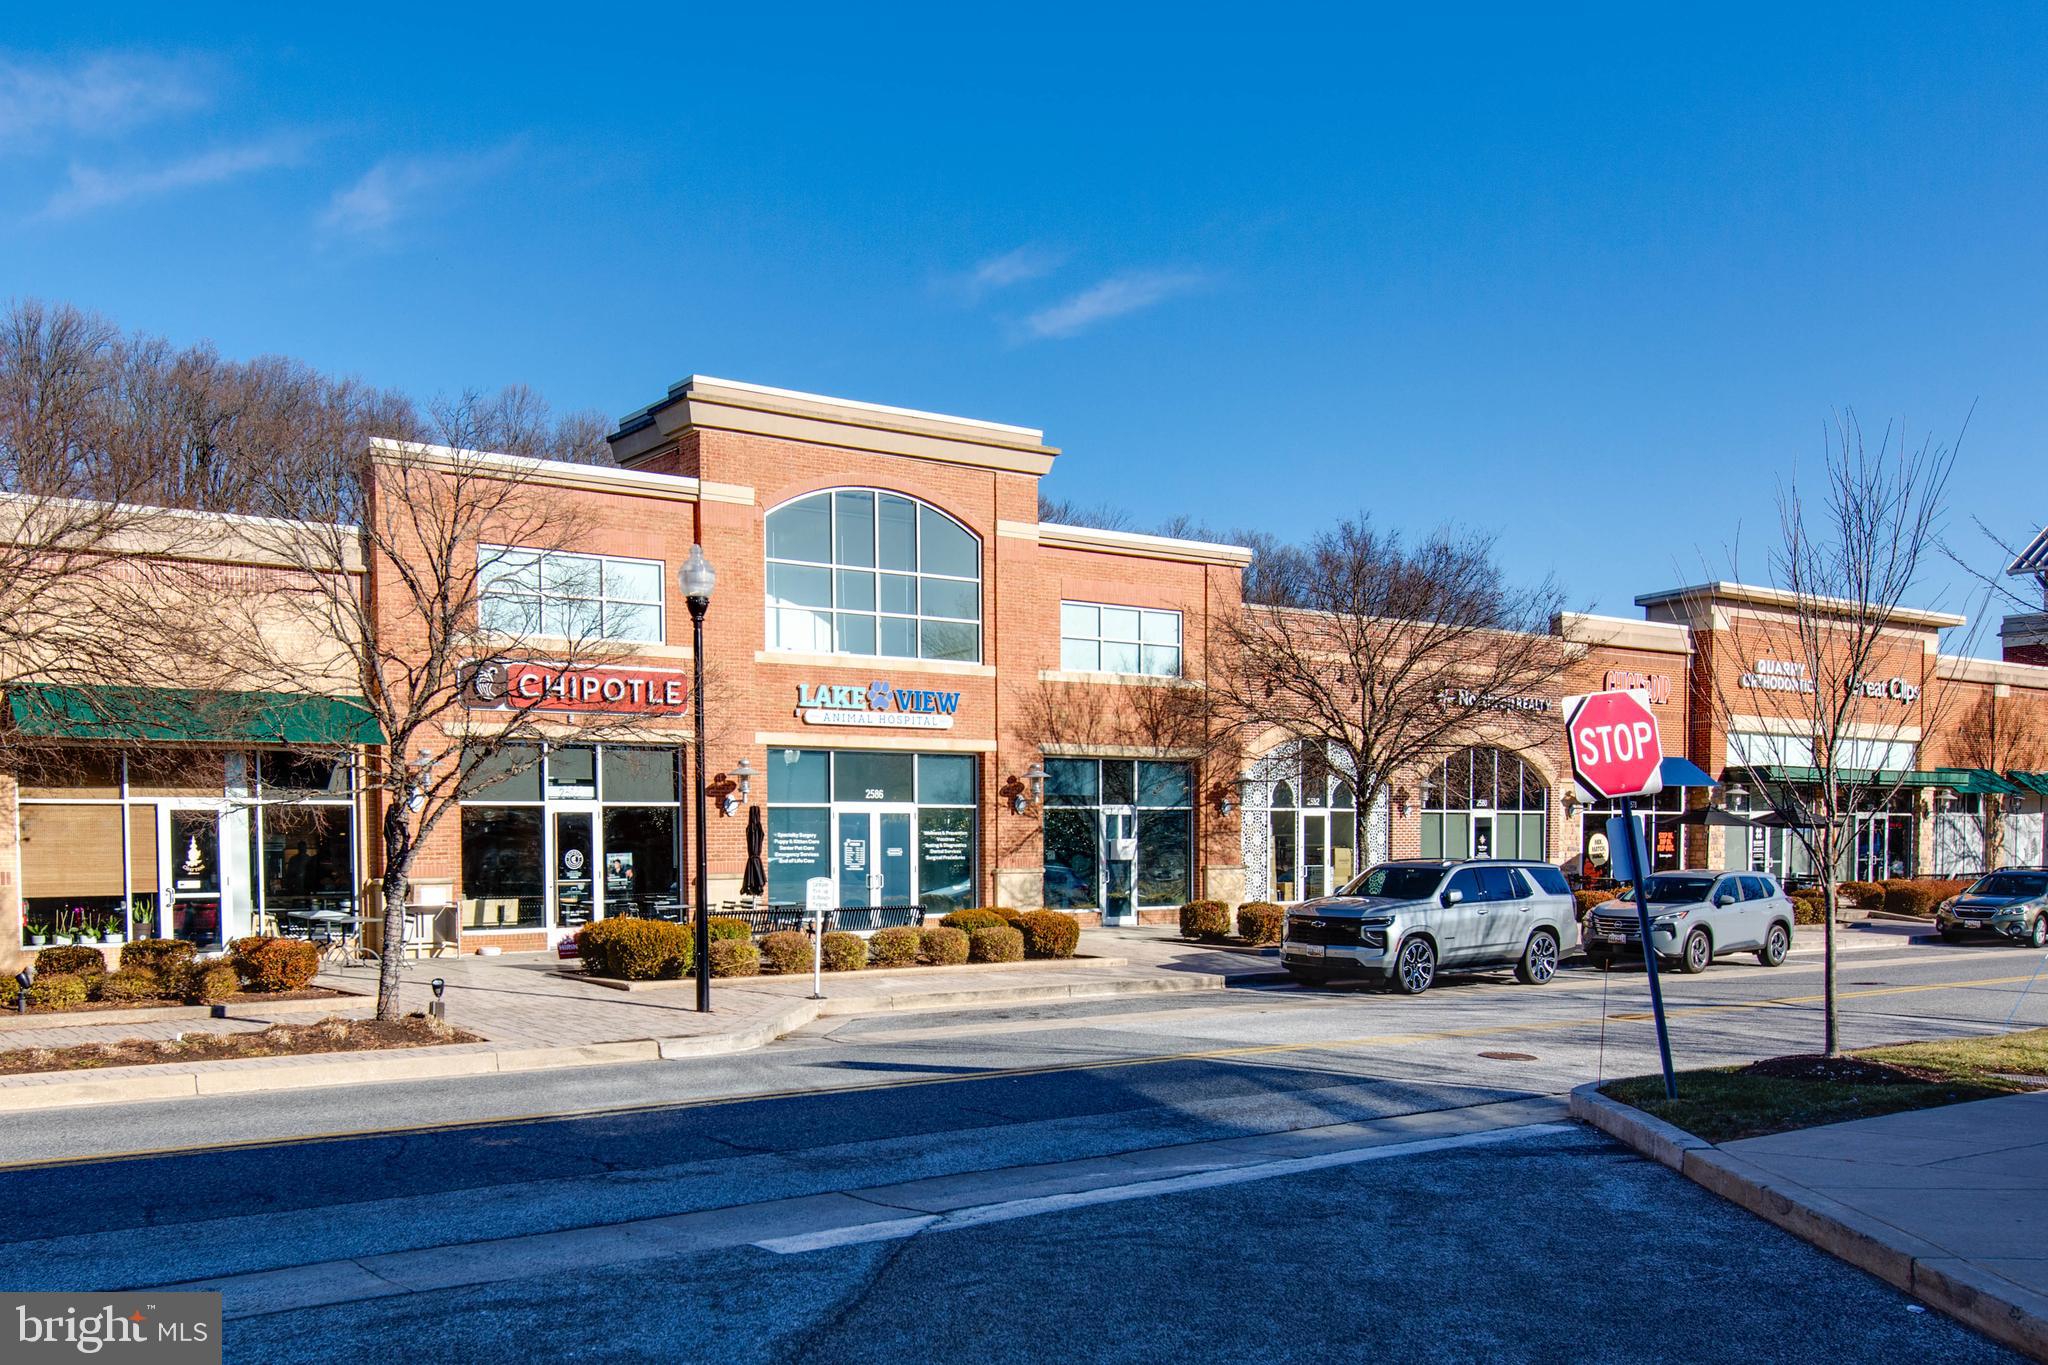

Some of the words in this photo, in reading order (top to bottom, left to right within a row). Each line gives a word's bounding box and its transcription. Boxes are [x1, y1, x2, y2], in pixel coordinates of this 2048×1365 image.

[1756, 659, 1806, 677] QUARRY
[518, 673, 683, 704] CHIPOTLE
[1651, 675, 1670, 703] DIP
[1742, 673, 1816, 693] ORTHODONTIC
[1889, 677, 1921, 705] Clips
[798, 683, 867, 710] LAKE
[896, 689, 960, 713] VIEW
[1516, 697, 1552, 711] REALTY
[823, 712, 873, 724] ANIMAL
[879, 714, 938, 726] HOSPITAL
[1580, 721, 1652, 766] STOP
[865, 789, 884, 799] 2586
